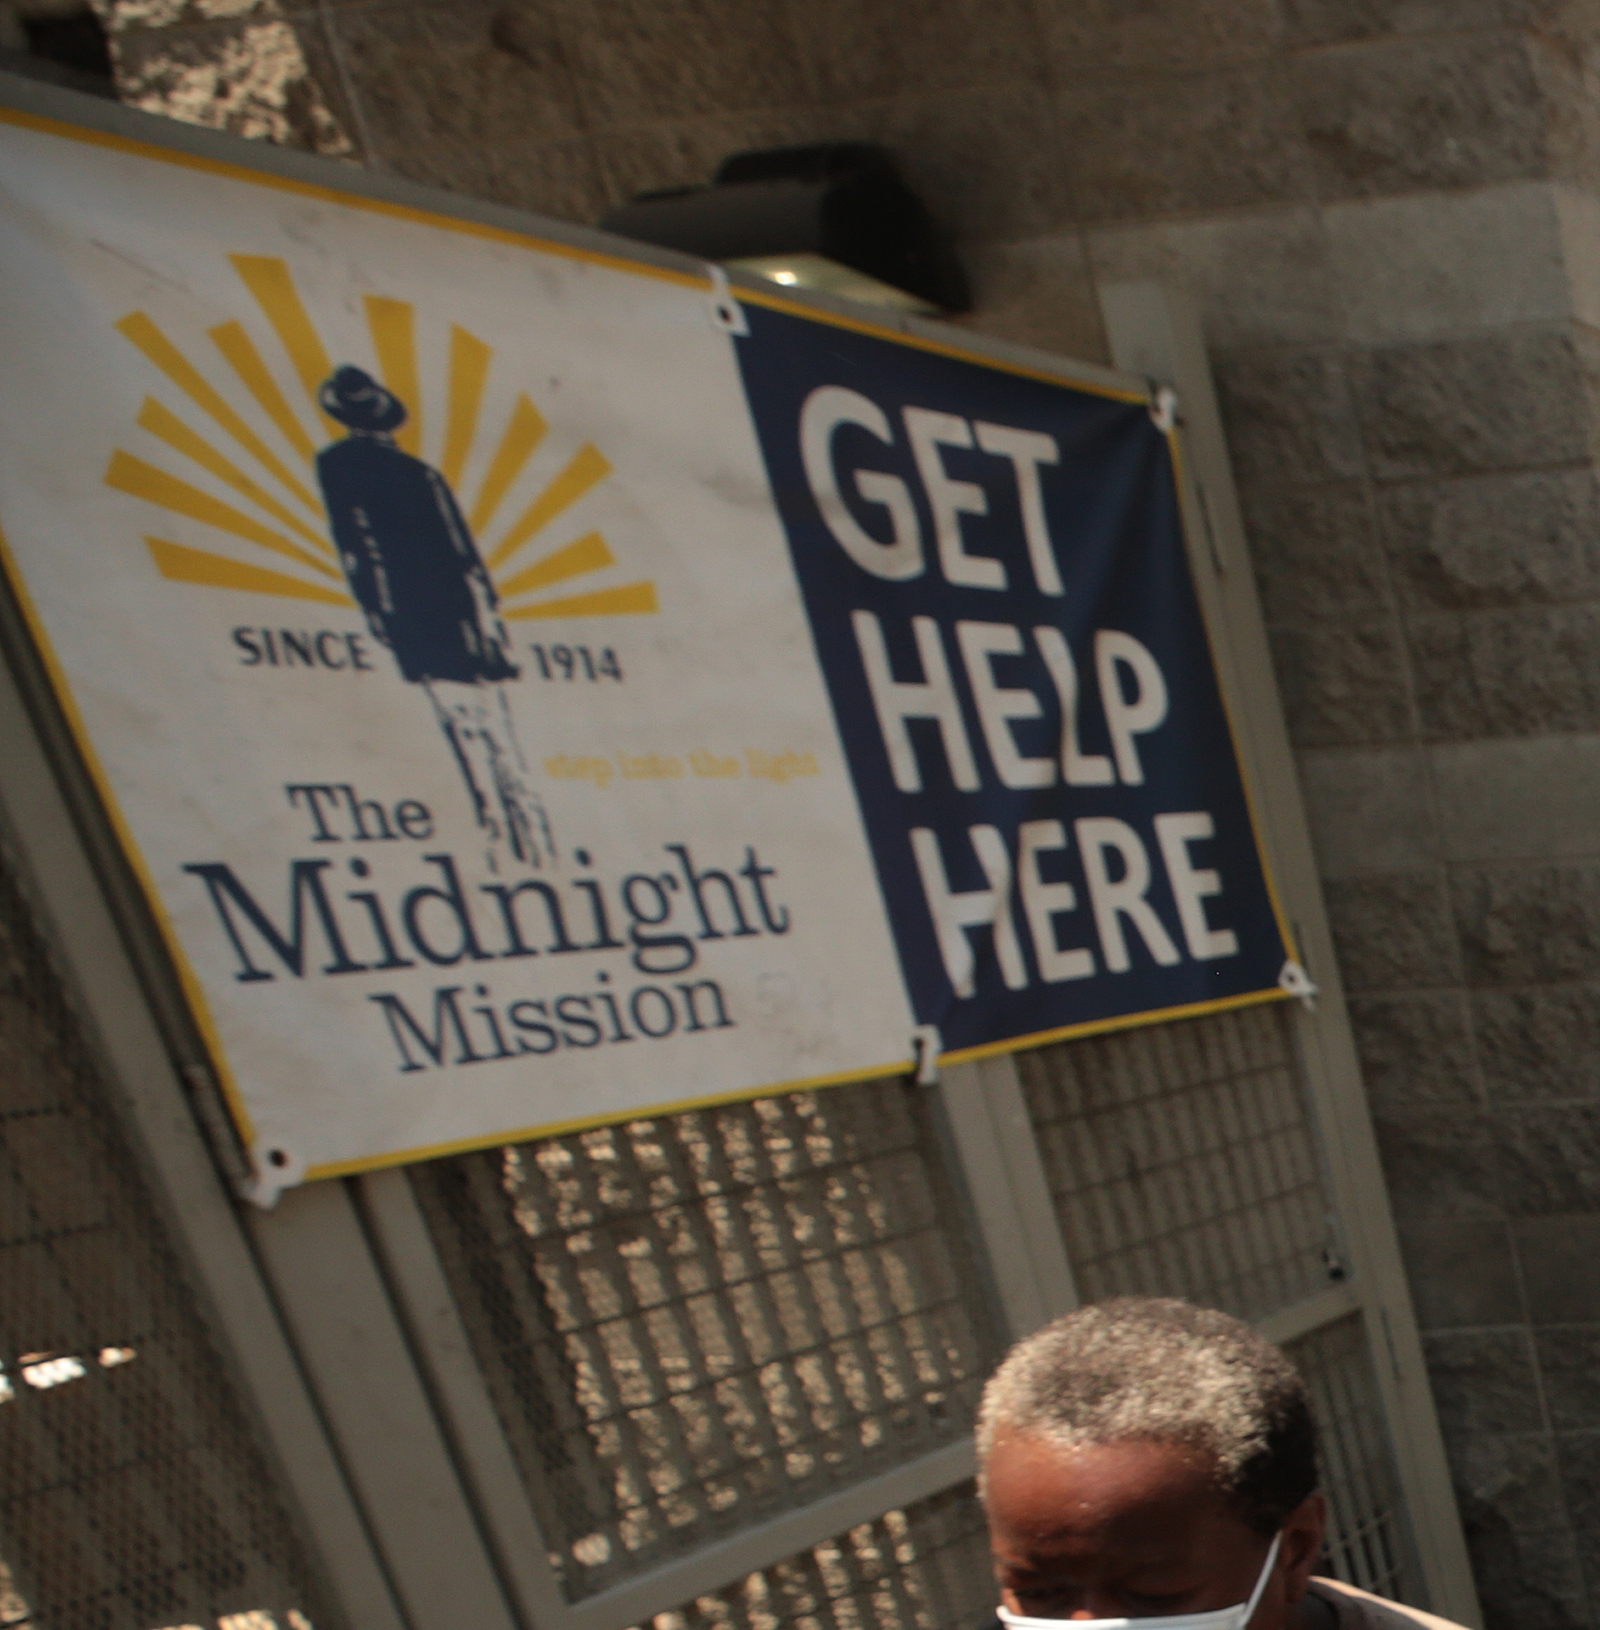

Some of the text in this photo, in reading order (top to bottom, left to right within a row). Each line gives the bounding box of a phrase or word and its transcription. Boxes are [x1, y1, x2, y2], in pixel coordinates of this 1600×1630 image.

[800, 385, 1065, 598] GET
[231, 625, 624, 683] SINCE 1914
[850, 609, 1169, 793] HELP
[285, 782, 436, 843] The
[181, 844, 792, 976] Midnight
[909, 811, 1239, 999] HERE
[369, 973, 737, 1073] Mission
